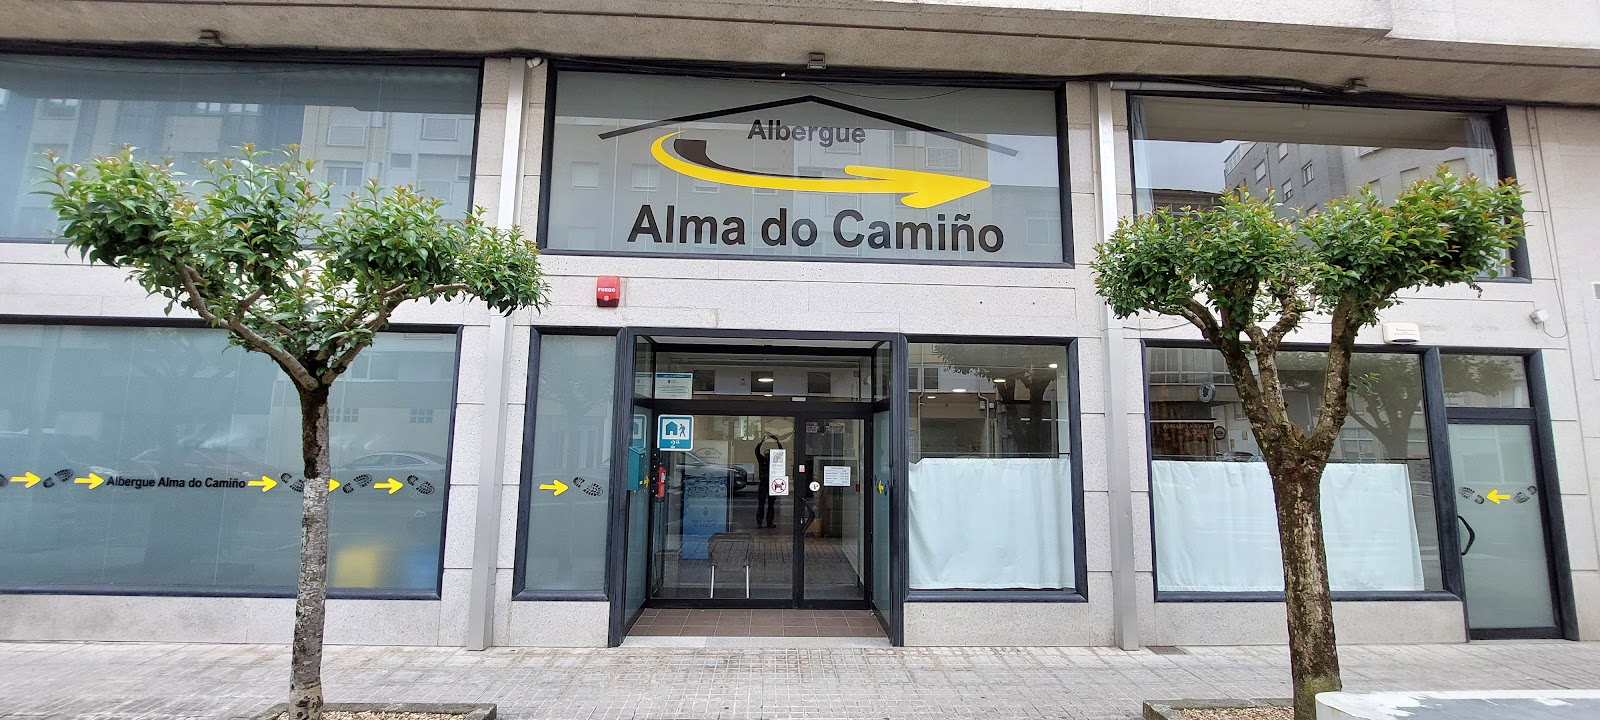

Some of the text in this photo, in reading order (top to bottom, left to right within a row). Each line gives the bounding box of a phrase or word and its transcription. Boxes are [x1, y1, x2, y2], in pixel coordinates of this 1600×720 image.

[747, 119, 866, 147] Albergue
[627, 204, 1004, 252] Alma do Camiño
[106, 476, 246, 489] Albergue Alma do Camiño
